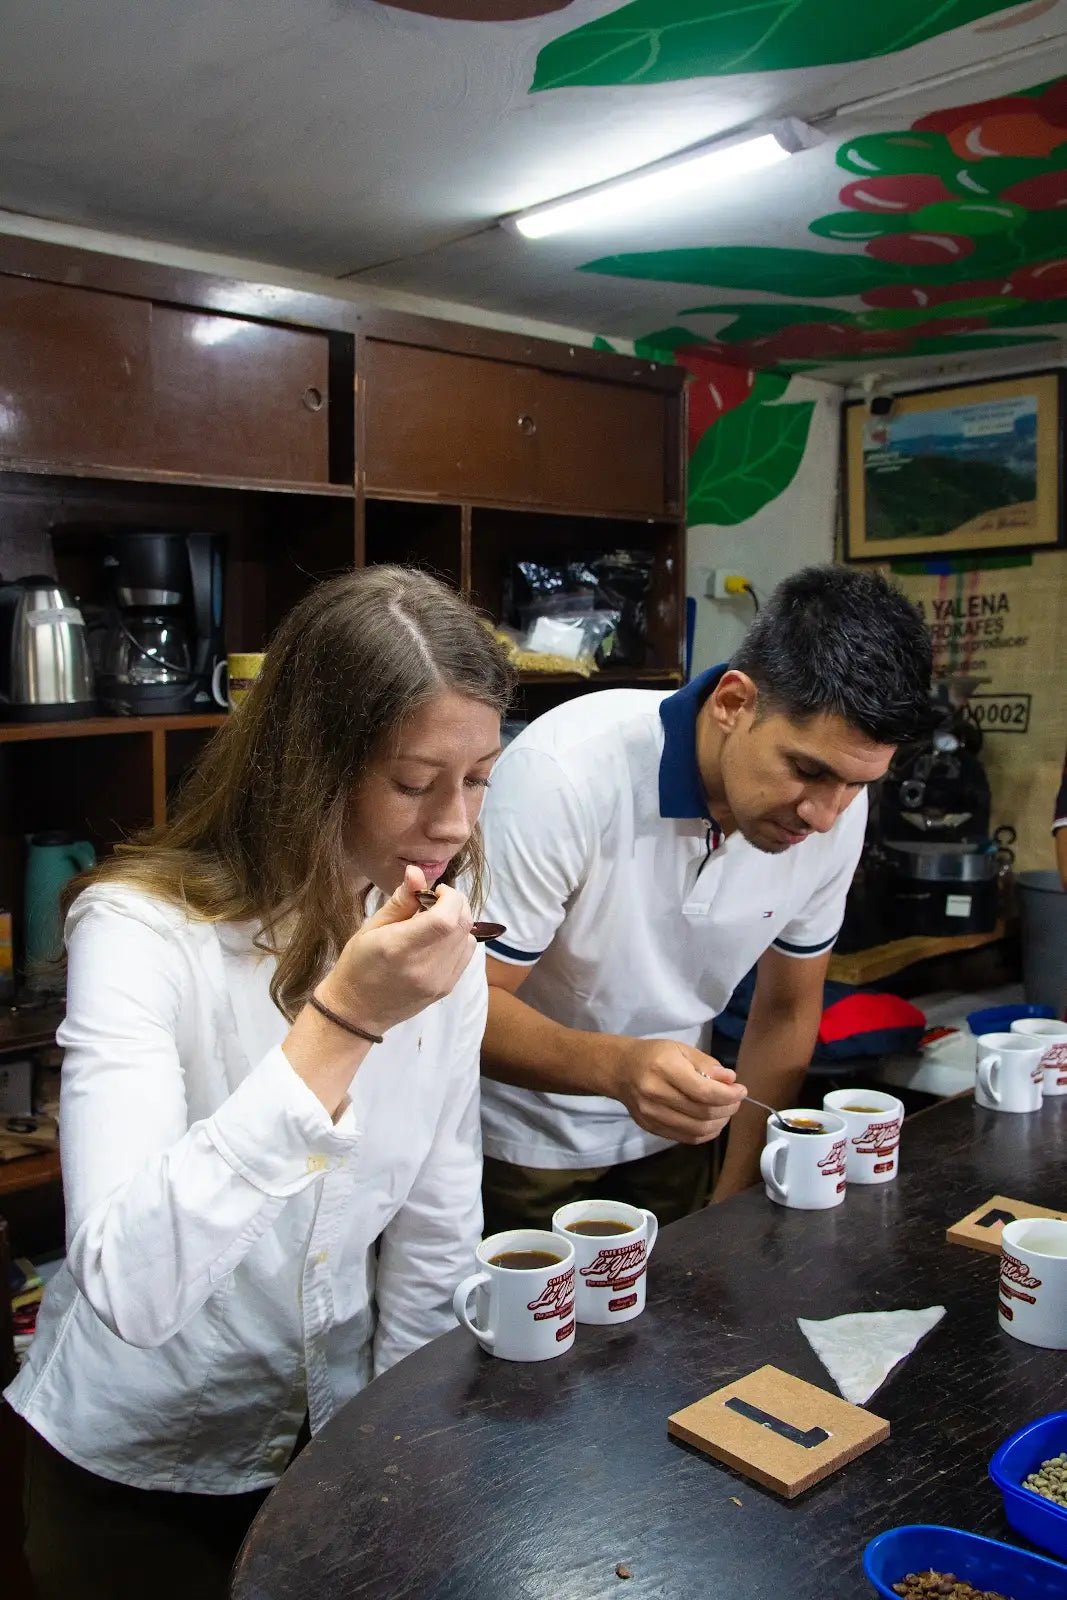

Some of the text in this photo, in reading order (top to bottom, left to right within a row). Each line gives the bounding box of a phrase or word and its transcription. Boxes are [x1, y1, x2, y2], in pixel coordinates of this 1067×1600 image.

[932, 592, 1010, 619] YALENA
[580, 1256, 610, 1276] La
[527, 1286, 557, 1310] La
